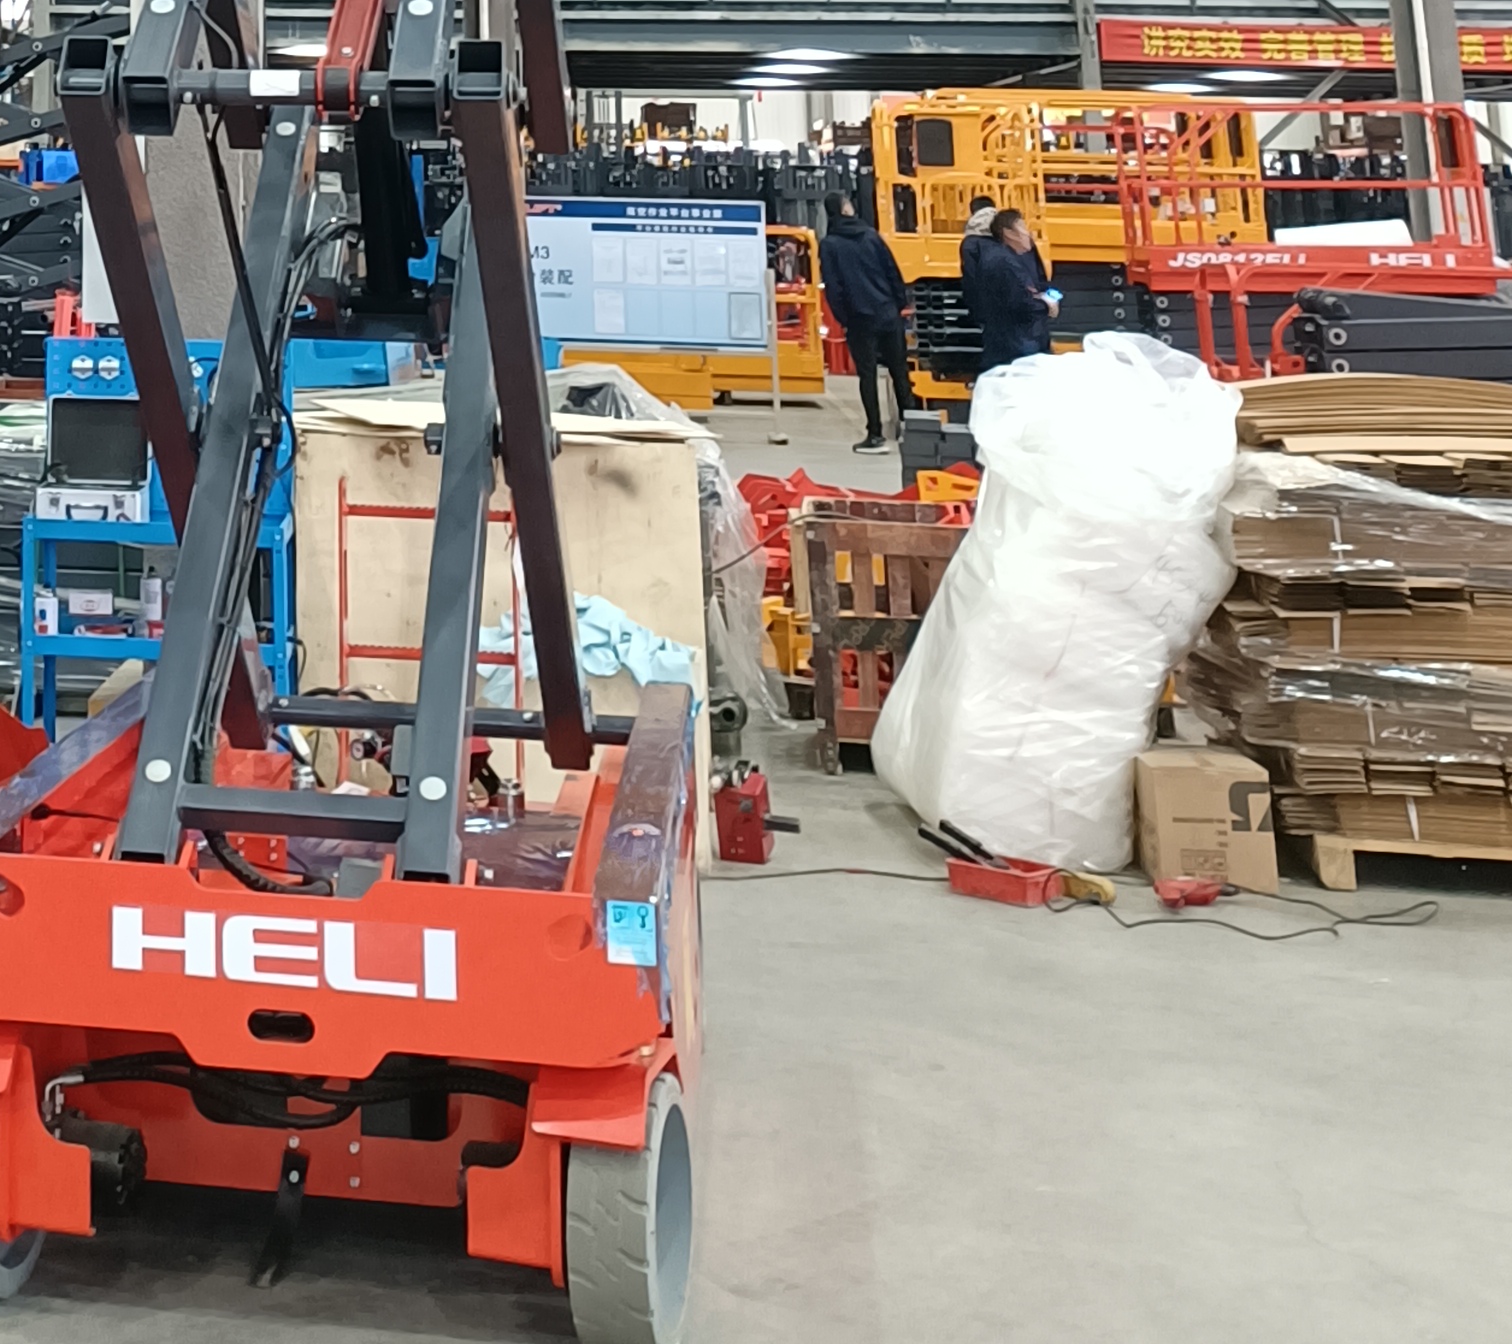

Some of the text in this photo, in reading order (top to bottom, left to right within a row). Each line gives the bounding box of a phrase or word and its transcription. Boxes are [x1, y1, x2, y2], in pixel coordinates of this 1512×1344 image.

[1140, 25, 1246, 59] 讲究实效
[1259, 30, 1366, 63] 完善管理
[111, 905, 458, 1002] HELI
